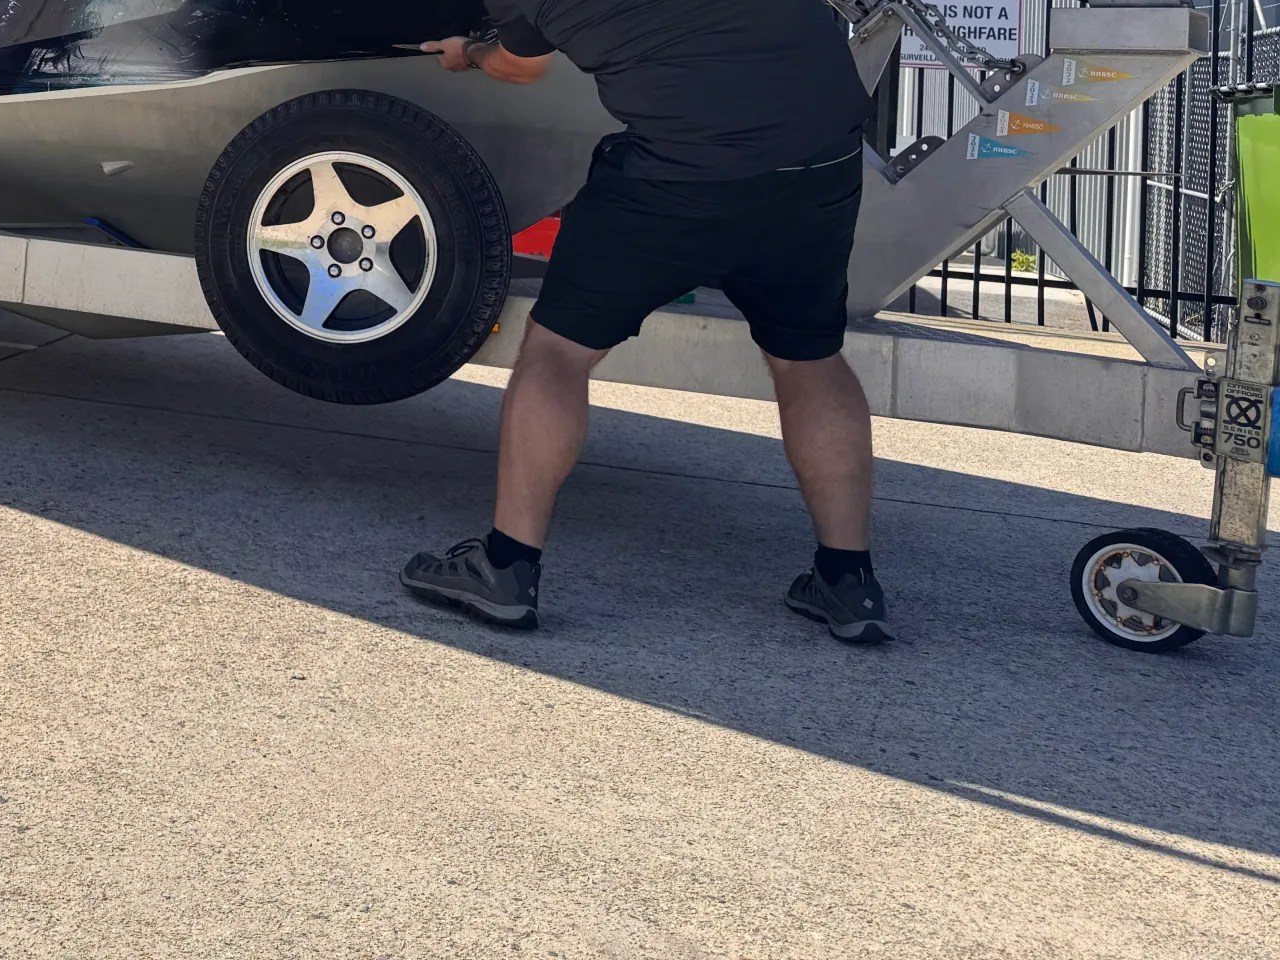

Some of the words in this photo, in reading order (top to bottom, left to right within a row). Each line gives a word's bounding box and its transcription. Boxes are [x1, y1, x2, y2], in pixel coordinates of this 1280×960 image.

[943, 4, 958, 19] IS
[962, 5, 993, 21] NOT
[997, 6, 1009, 21] A
[1226, 382, 1263, 394] EXTREME
[1226, 388, 1264, 399] OFFROAD
[1223, 425, 1261, 437] SERIES
[1221, 431, 1261, 449] 750
